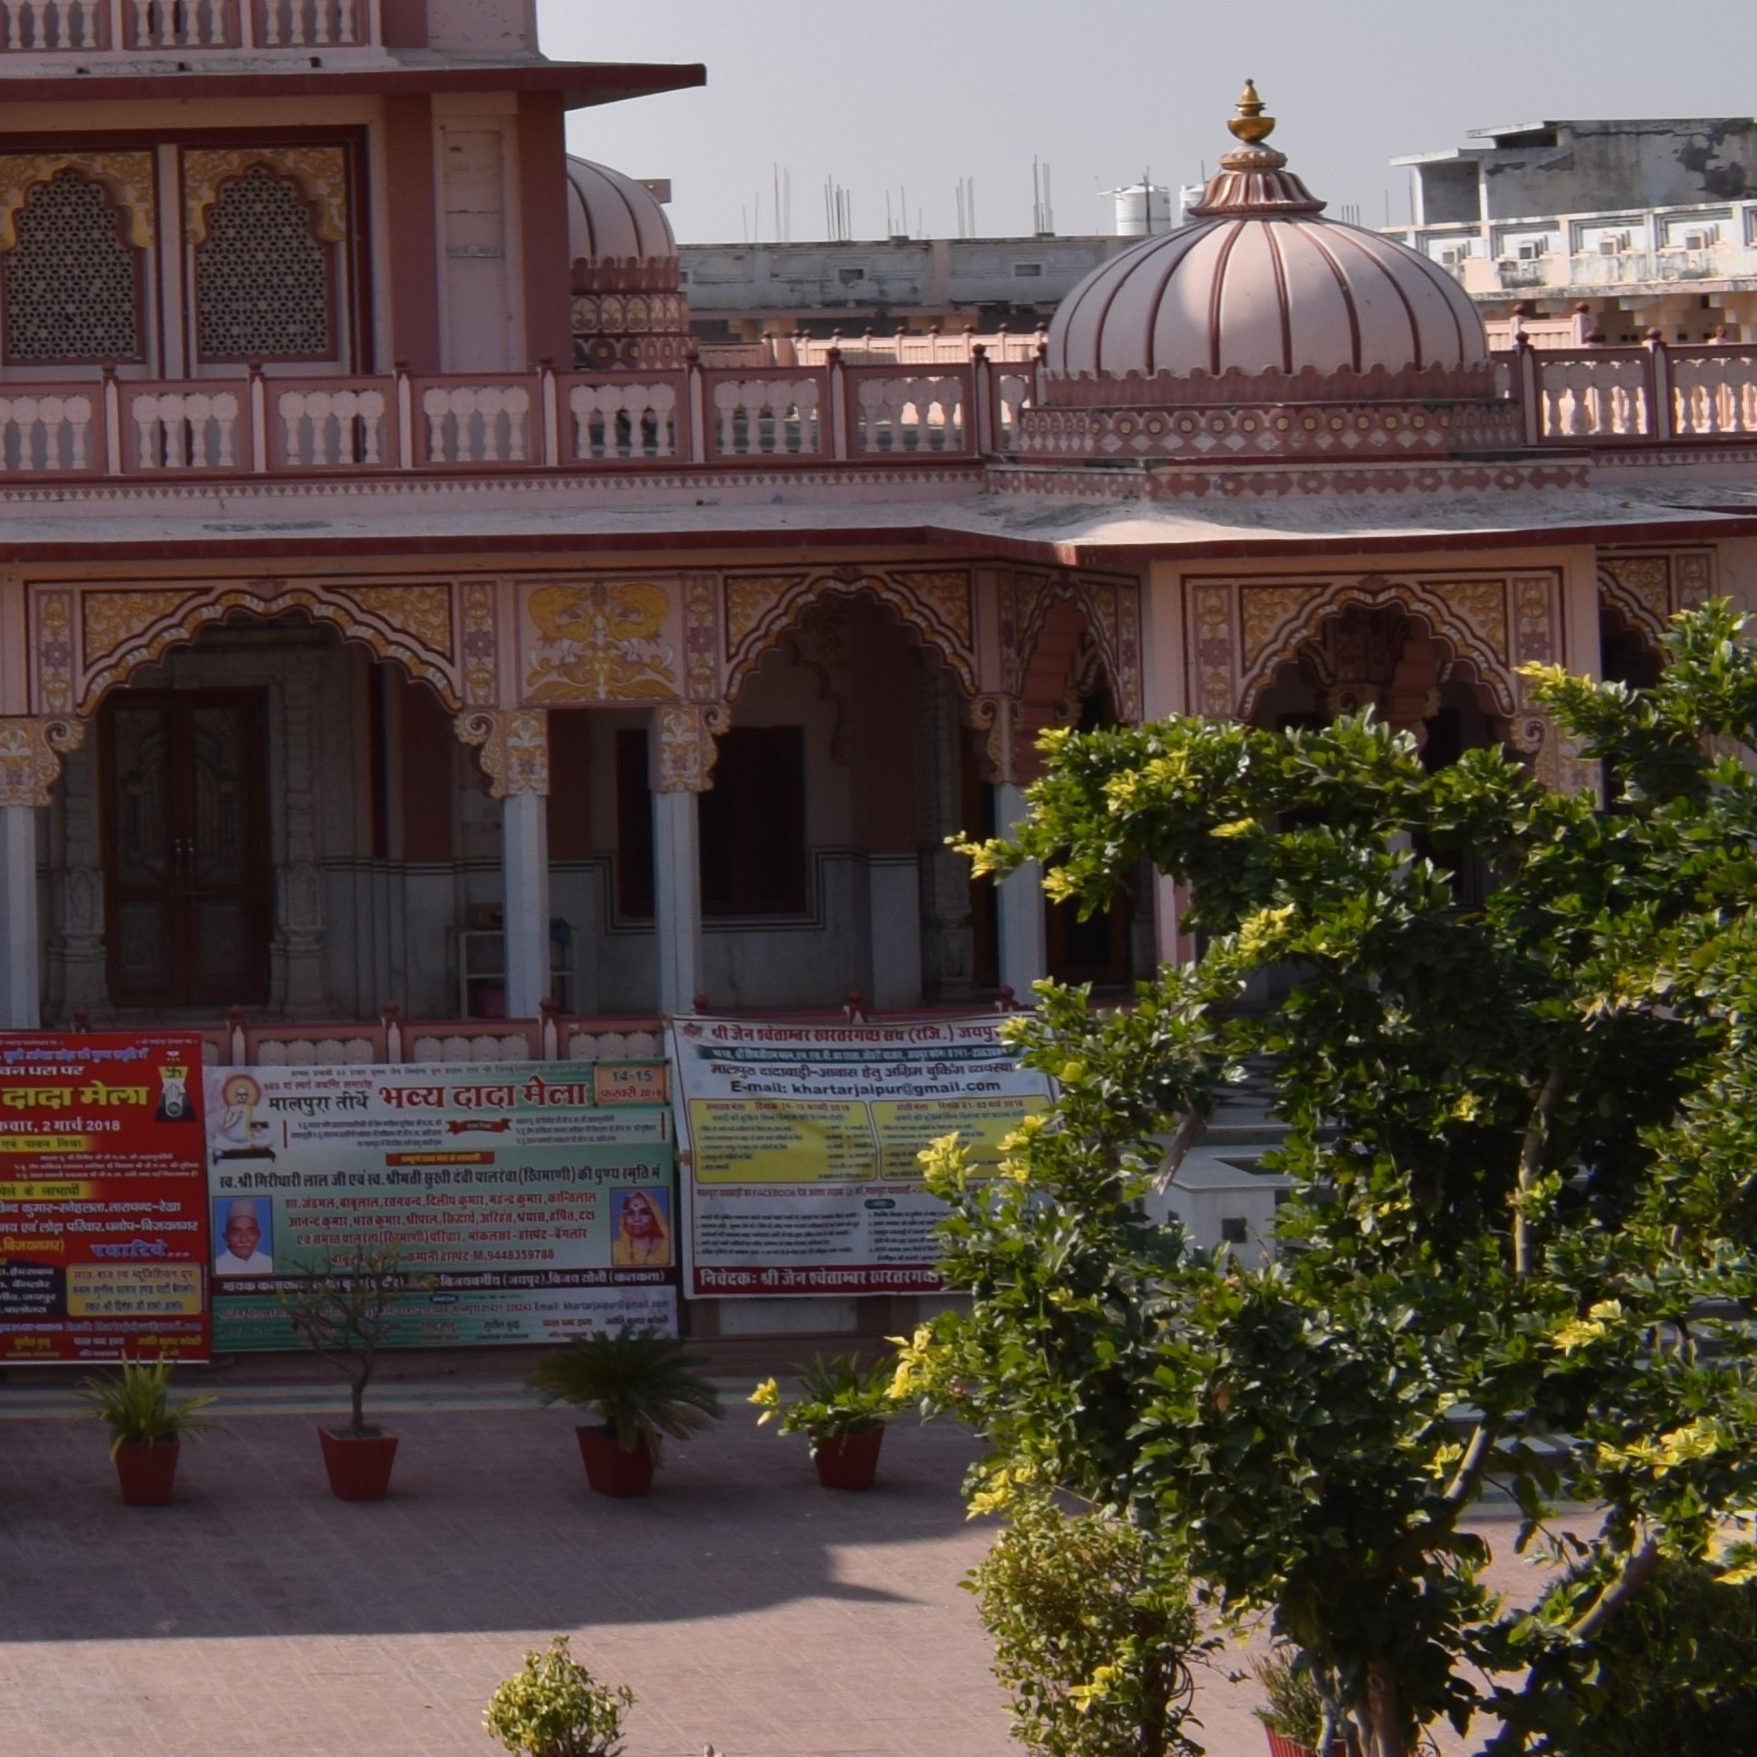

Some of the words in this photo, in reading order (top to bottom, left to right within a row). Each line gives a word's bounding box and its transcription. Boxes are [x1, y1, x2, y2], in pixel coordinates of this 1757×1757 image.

[711, 1025, 728, 1040] श्री
[729, 1024, 754, 1040] जैन
[756, 1026, 810, 1041] श्वेताम्बर
[60, 1065, 85, 1076] पर
[612, 1070, 652, 1082] 14-15
[1, 1086, 74, 1110] दादा
[78, 1079, 150, 1105] मेला
[268, 1096, 330, 1116] मालपुरा
[379, 1086, 446, 1109] भव्य
[451, 1084, 517, 1110] दादा
[522, 1075, 587, 1106] मेला
[600, 1087, 637, 1099] फरवरी
[731, 1081, 787, 1093] E-mail:
[791, 1082, 1001, 1097] khartarjaipur@gmail.com
[42, 1120, 51, 1131] 2
[54, 1116, 83, 1131] मार्च
[85, 1120, 120, 1131] 2018
[303, 1174, 328, 1187] लाल
[331, 1171, 346, 1186] जी
[453, 1168, 472, 1184] देवी
[594, 1167, 619, 1185] पुण्य
[623, 1164, 649, 1183] स्मृति
[651, 1163, 662, 1179] में
[761, 1267, 778, 1285] श्री
[782, 1268, 805, 1285] जैन
[809, 1268, 865, 1285] श्वेताम्बर
